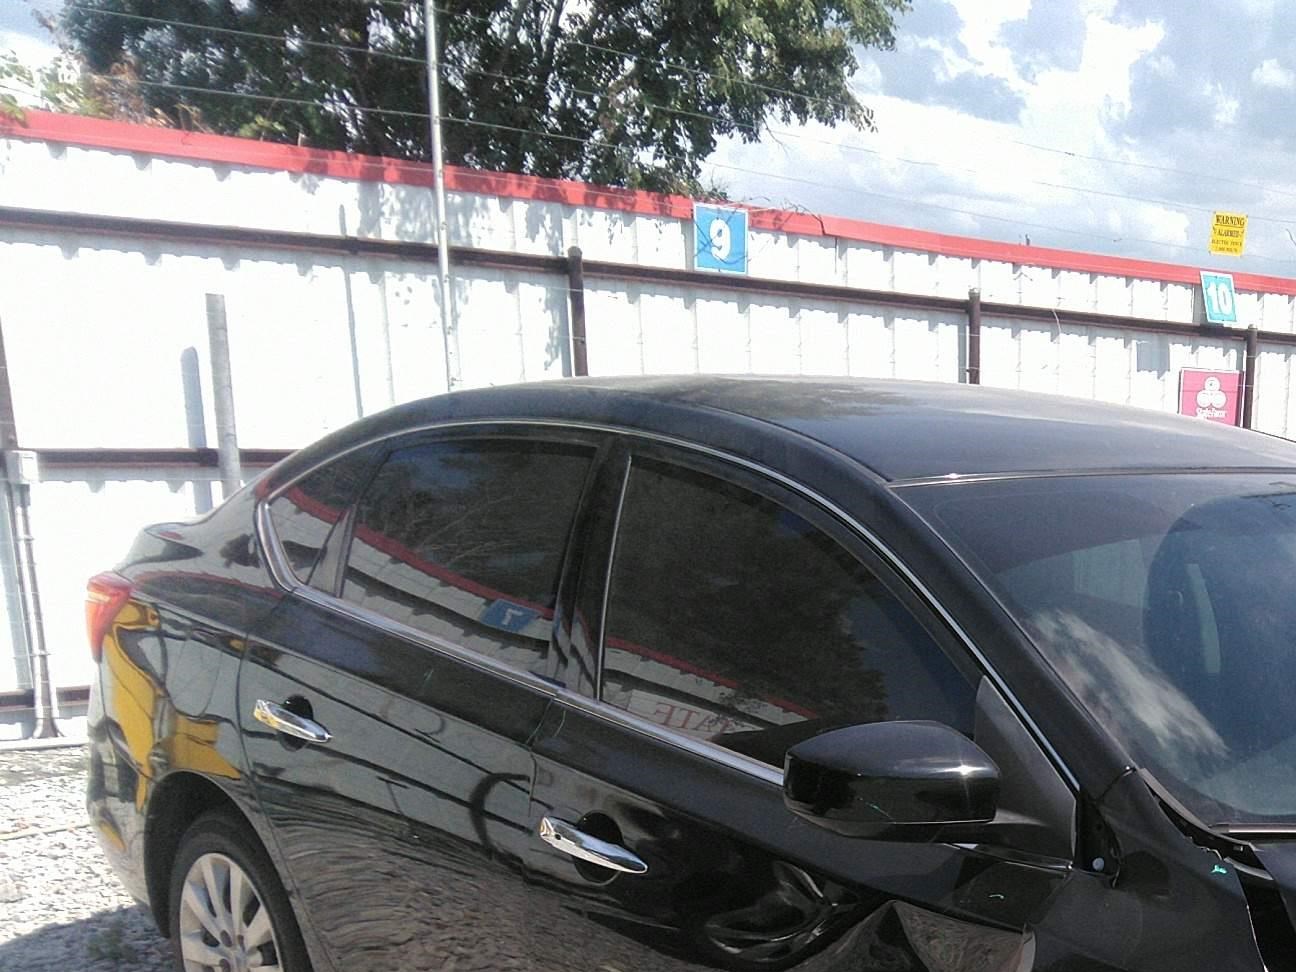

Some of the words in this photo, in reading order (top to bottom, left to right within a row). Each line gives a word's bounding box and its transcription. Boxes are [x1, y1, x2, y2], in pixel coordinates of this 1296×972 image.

[1215, 214, 1245, 226] WARNING
[709, 218, 731, 261] 9
[1206, 282, 1233, 315] 10
